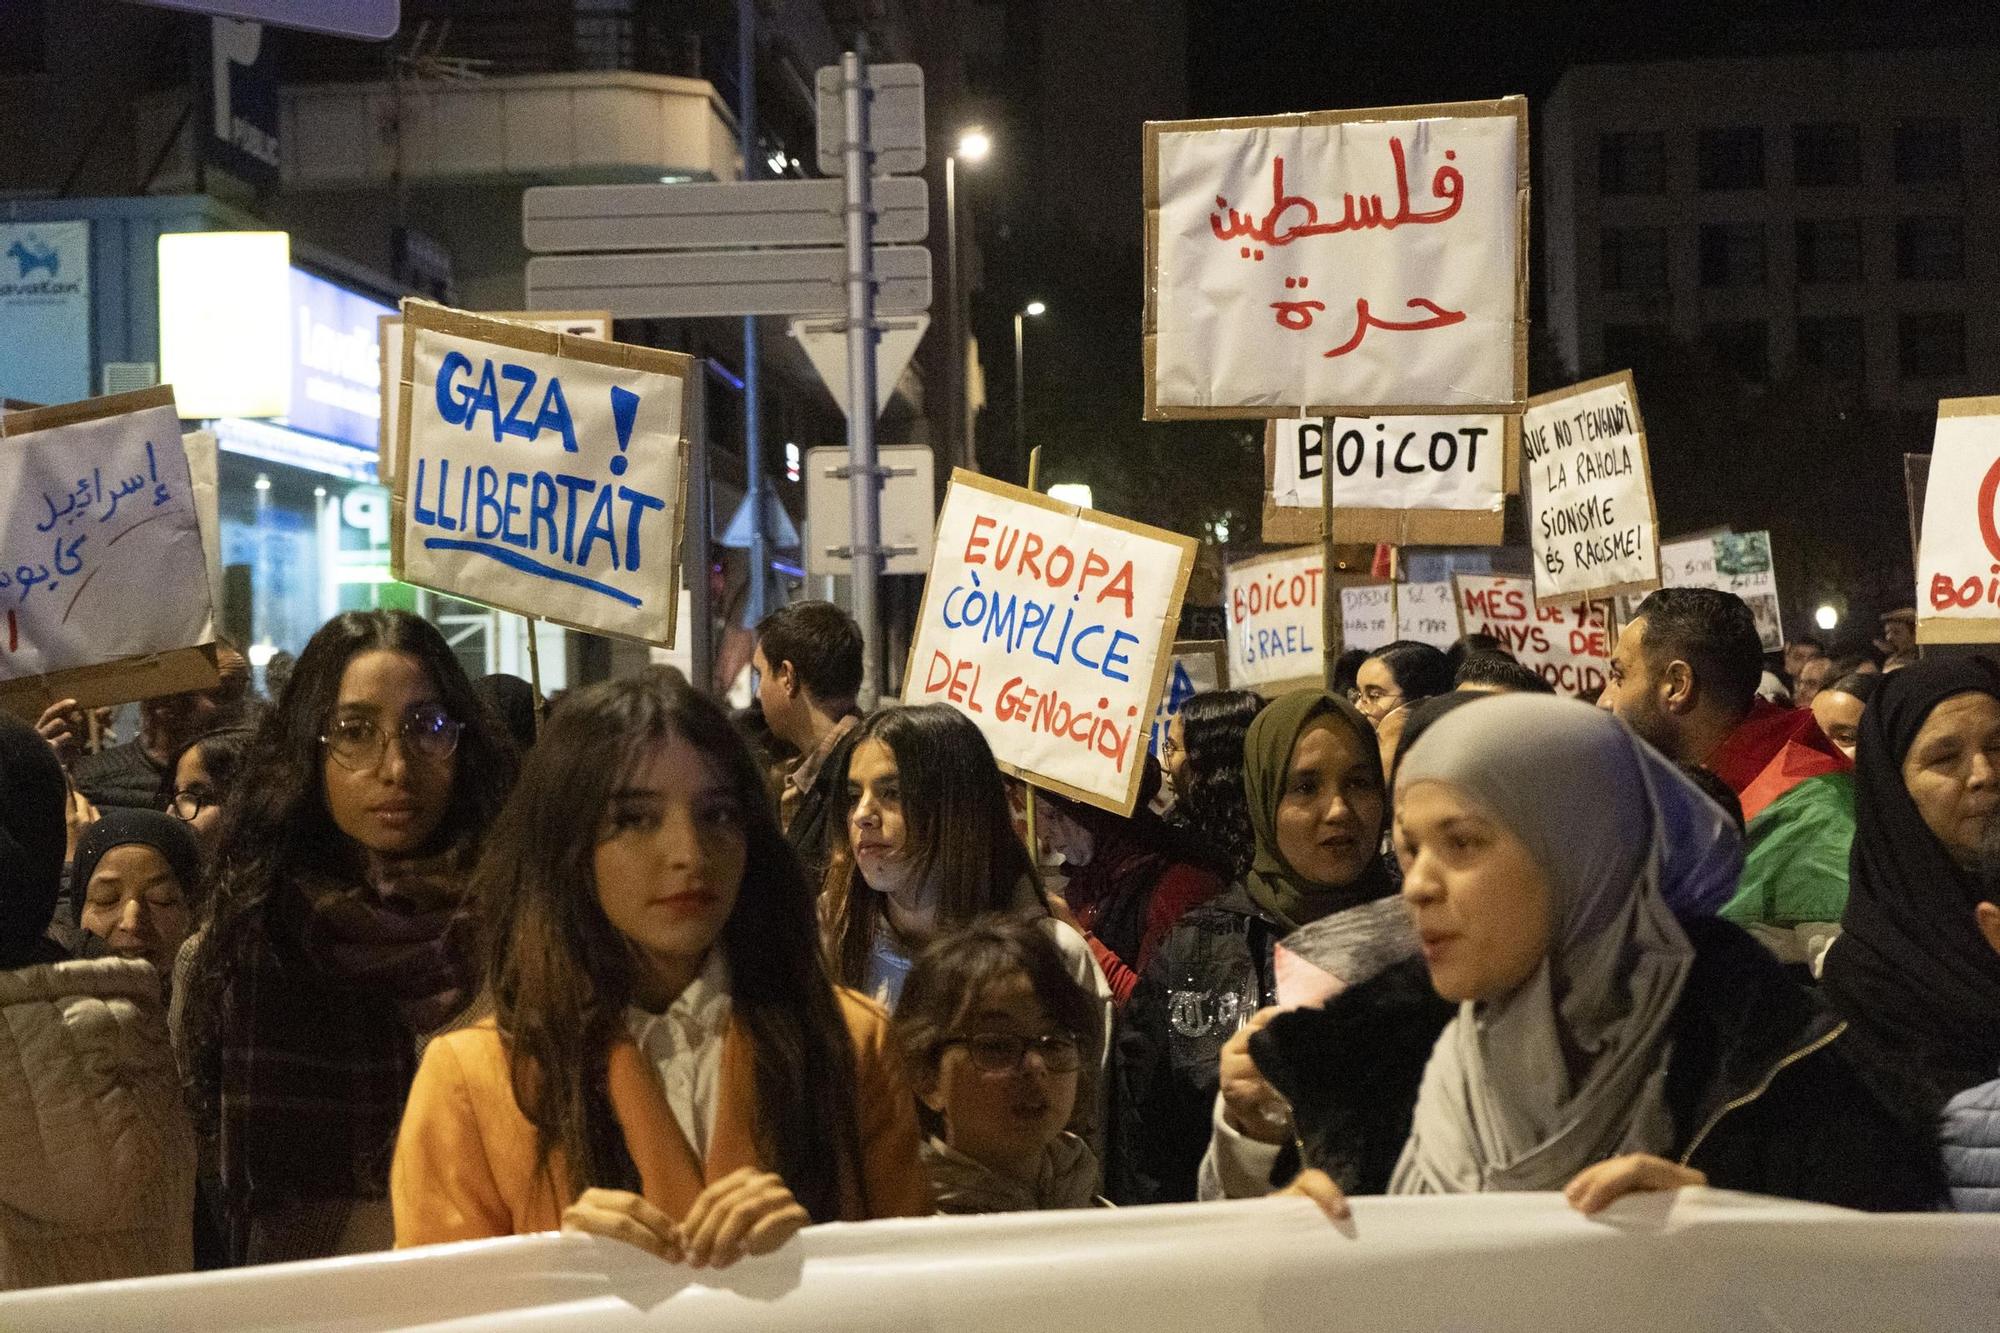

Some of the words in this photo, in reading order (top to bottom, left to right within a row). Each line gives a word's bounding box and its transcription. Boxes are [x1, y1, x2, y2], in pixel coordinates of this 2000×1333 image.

[1209, 136, 1464, 261] فلسطين
[1270, 277, 1467, 358] حرة
[436, 350, 578, 453] GAZA
[1522, 426, 1549, 462] QUE
[1554, 417, 1572, 450] NO
[36, 441, 172, 533] إسرائيل
[1547, 463, 1567, 492] LA
[1576, 445, 1632, 485] RAHOLA
[415, 459, 665, 571] LLIBERTAT
[964, 514, 1134, 618] EUROPA
[1465, 578, 1527, 621] MÉS
[1480, 623, 1549, 653] ANYS
[925, 650, 983, 713] DEL
